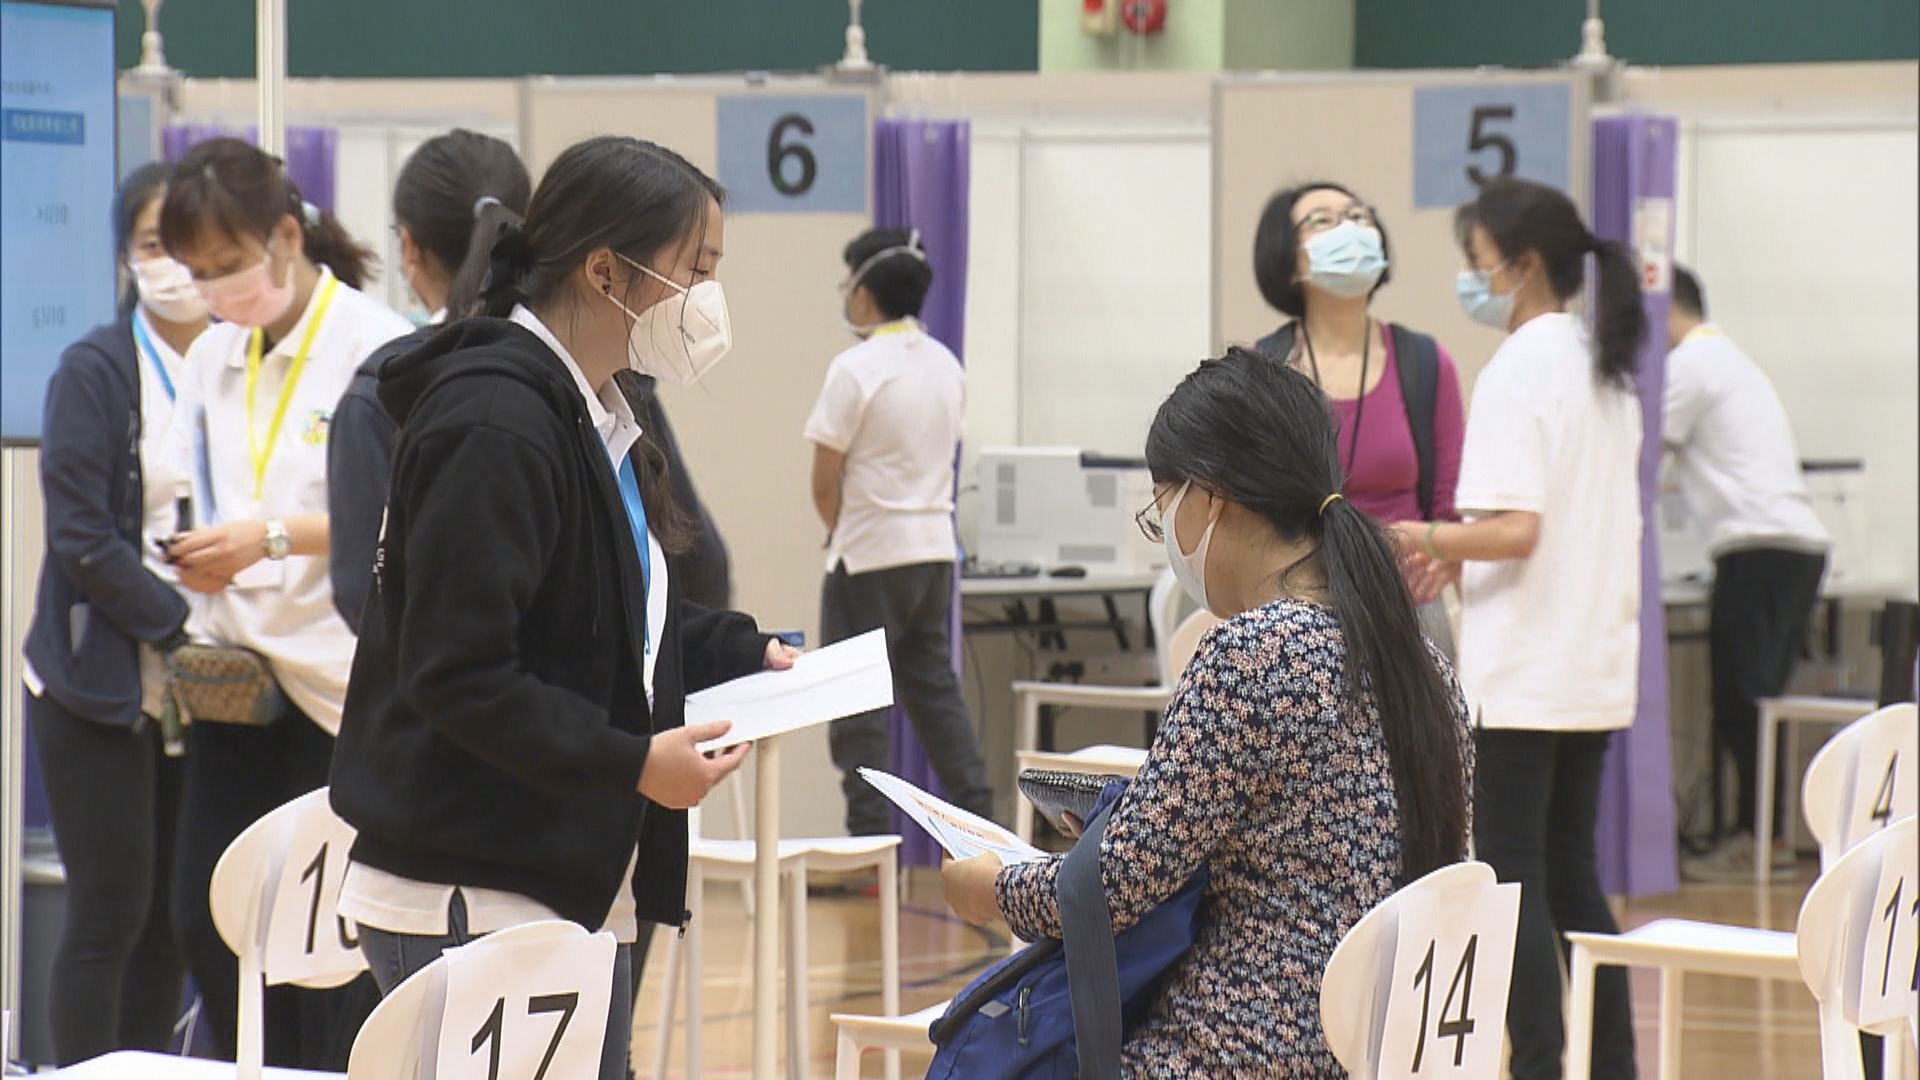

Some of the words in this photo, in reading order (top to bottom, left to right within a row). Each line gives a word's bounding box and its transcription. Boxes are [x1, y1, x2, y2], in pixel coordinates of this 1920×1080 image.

[767, 113, 817, 197] 6
[1465, 104, 1516, 186] 5
[1872, 750, 1898, 829] 4
[471, 991, 579, 1080] 17
[1411, 934, 1478, 1073] 14
